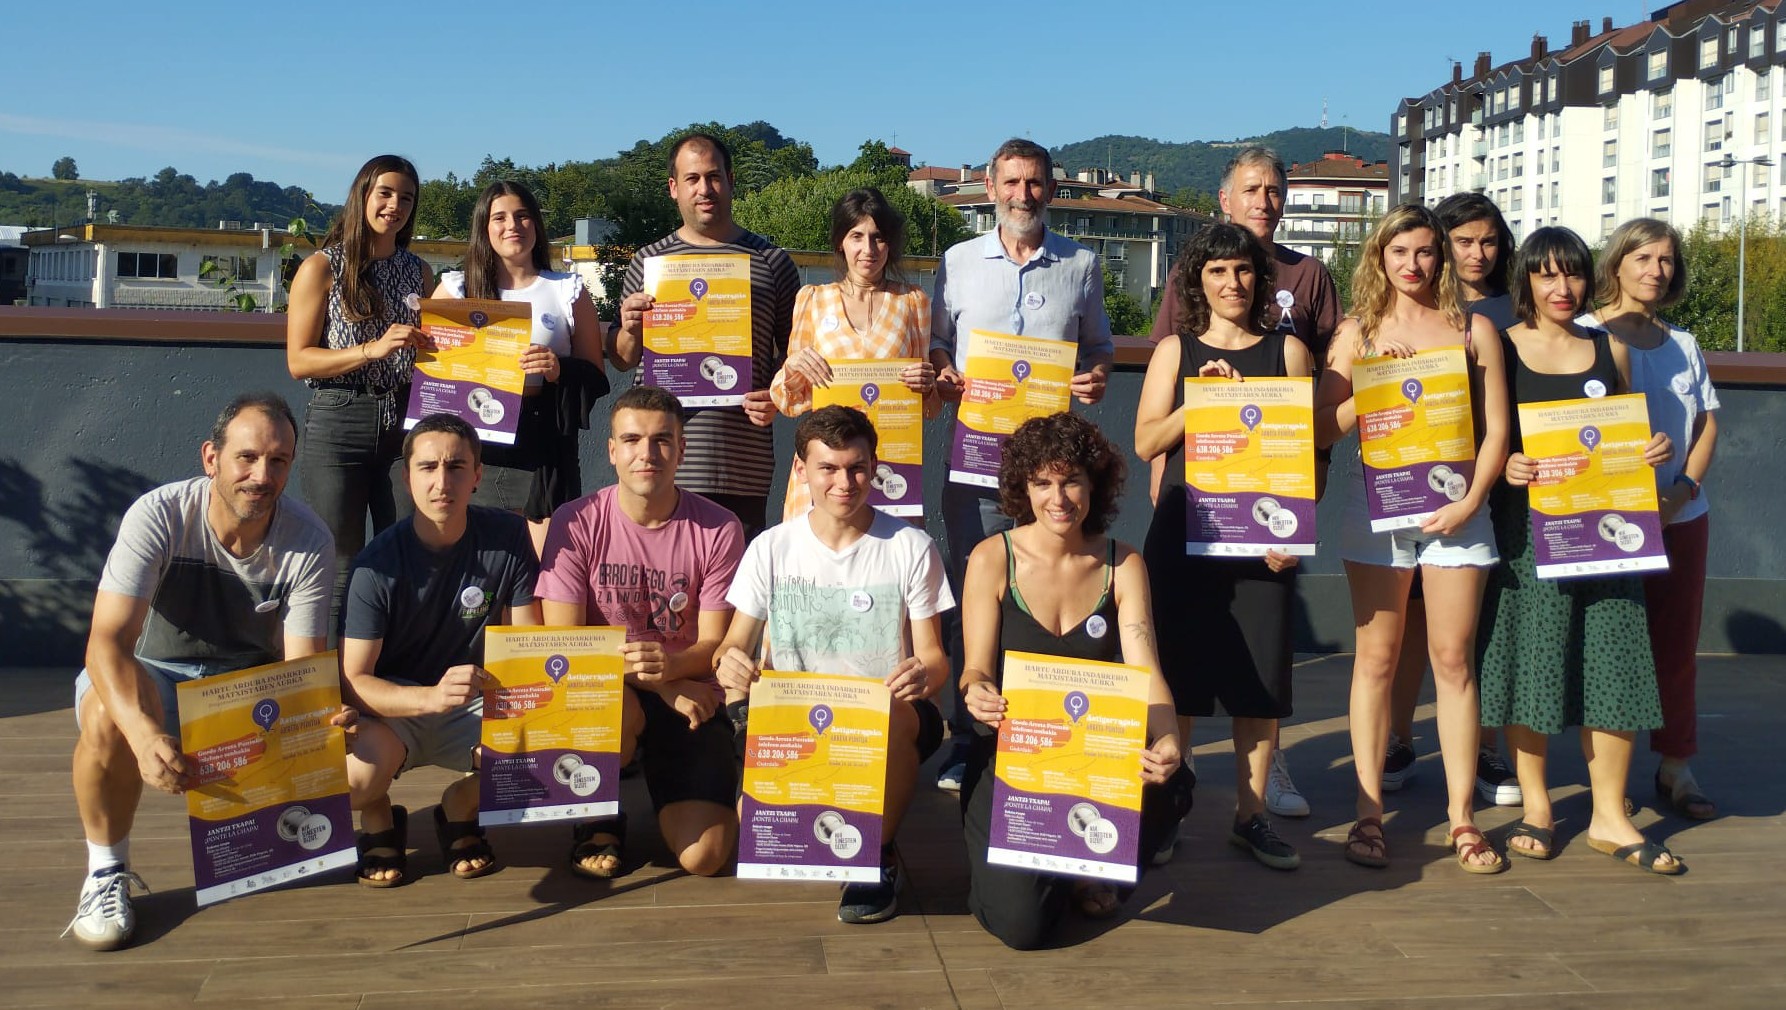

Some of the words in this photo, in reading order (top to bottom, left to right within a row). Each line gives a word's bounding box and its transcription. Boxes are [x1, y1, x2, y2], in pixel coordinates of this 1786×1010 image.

[1010, 733, 1023, 743] 638
[1025, 735, 1038, 745] 206
[1040, 736, 1052, 747] 586
[757, 749, 770, 758] 638
[772, 749, 784, 759] 206
[786, 750, 798, 759] 586
[199, 762, 214, 775] 638
[216, 759, 231, 771] 206
[233, 755, 247, 767] 586
